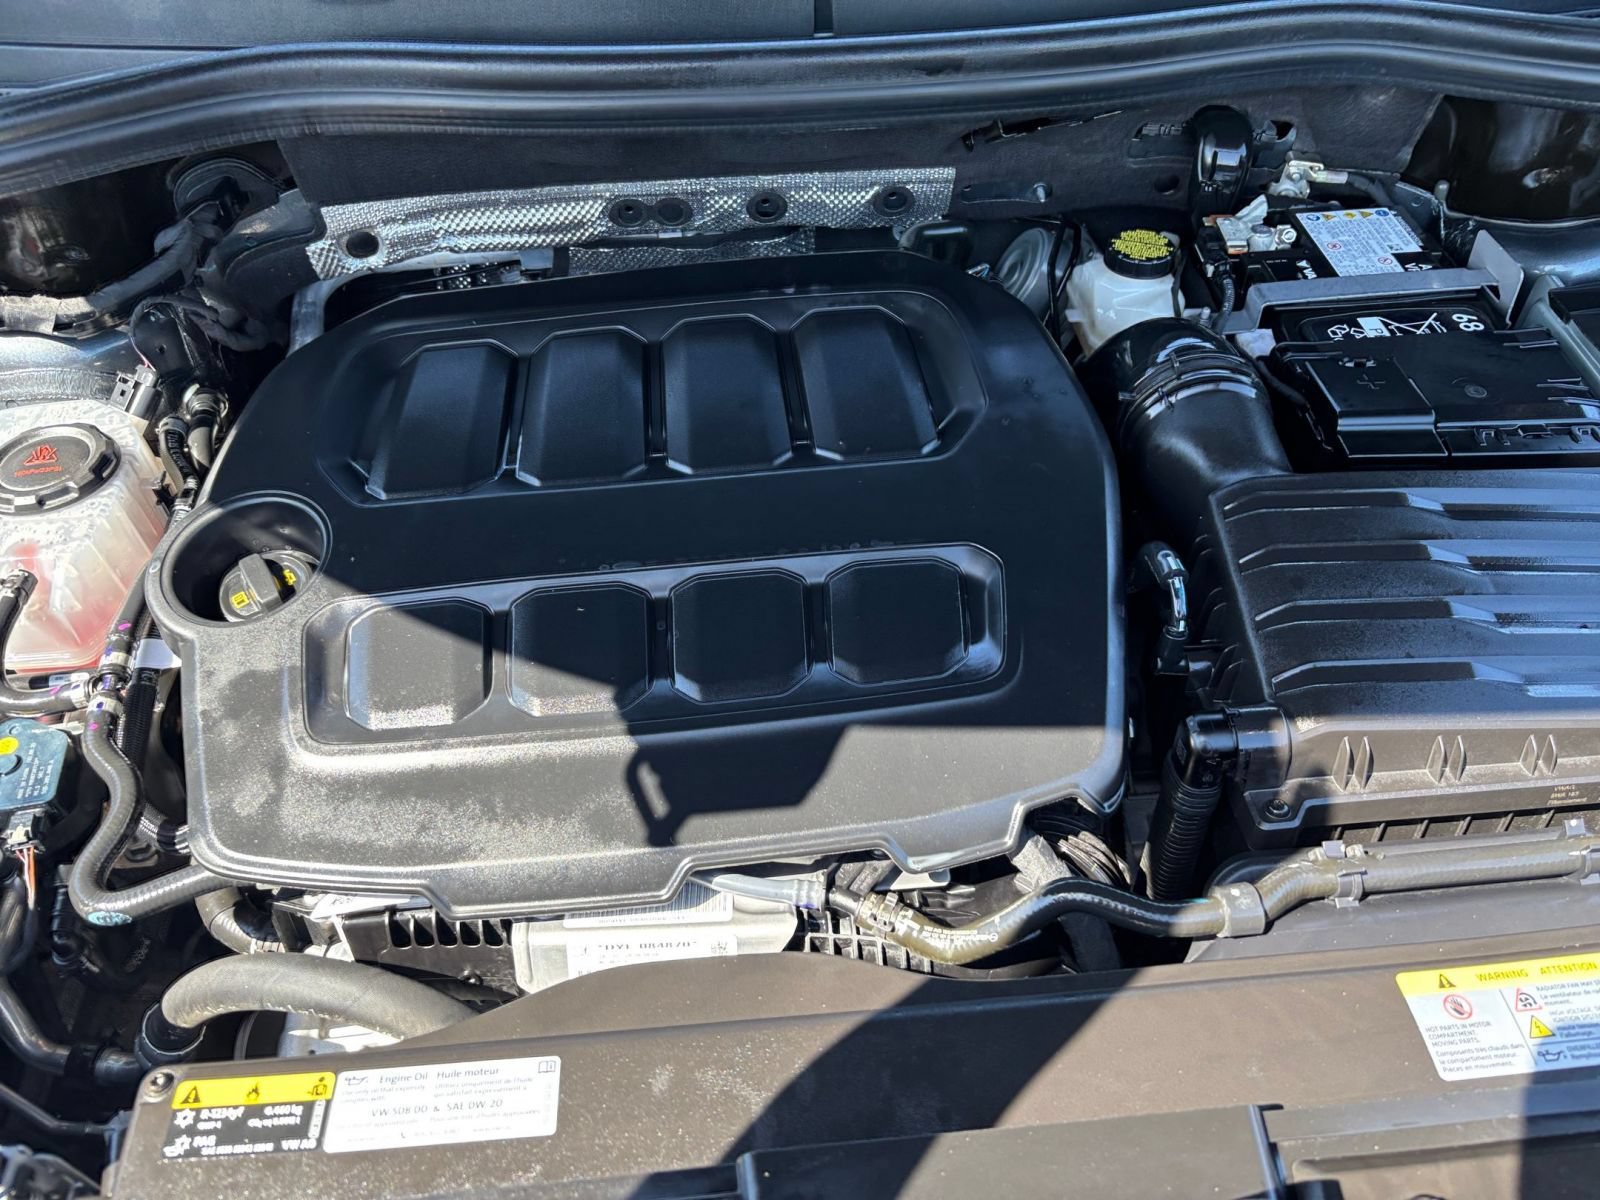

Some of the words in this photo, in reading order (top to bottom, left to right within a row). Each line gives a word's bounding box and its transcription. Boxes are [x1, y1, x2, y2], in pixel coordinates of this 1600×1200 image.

[1452, 313, 1484, 332] 68
[1477, 969, 1529, 982] WARNING
[1540, 962, 1598, 975] ATTENTION
[1536, 983, 1566, 992] RADIATOR
[1432, 1039, 1458, 1047] MOVING
[1435, 1048, 1475, 1057] Composants
[1446, 1054, 1493, 1064] compartiment
[379, 1073, 412, 1086] Engine
[414, 1071, 428, 1081] Oil
[436, 1070, 462, 1079] Huile
[464, 1067, 500, 1077] moteur
[371, 1106, 389, 1117] VW
[391, 1105, 411, 1115] 508
[413, 1104, 429, 1114] 00
[446, 1102, 465, 1112] SAE
[281, 1139, 300, 1151] VW
